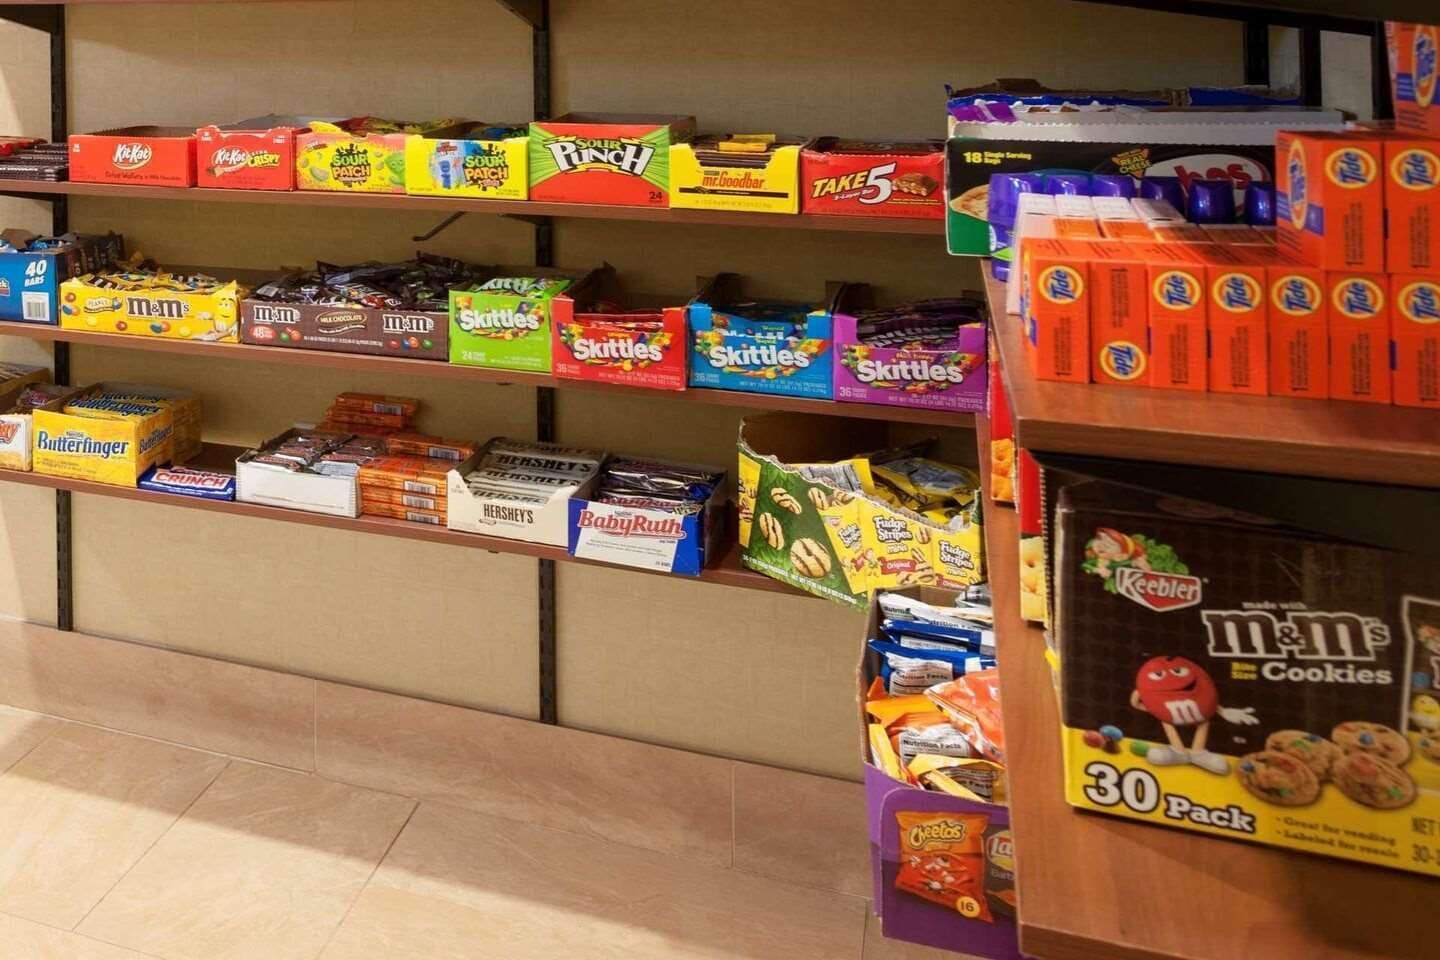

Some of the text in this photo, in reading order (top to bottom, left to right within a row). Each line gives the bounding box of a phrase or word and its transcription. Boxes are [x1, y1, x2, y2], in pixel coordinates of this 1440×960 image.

[576, 139, 621, 150] SOUR
[247, 153, 280, 167] CRISPY
[332, 153, 368, 166] SOUR
[465, 155, 506, 168] SOUR
[547, 140, 655, 177] PUNCH
[963, 151, 982, 164] 18
[1120, 155, 1147, 166] REAL
[1338, 150, 1369, 184] Tide
[332, 165, 372, 178] PATCH
[464, 167, 509, 180] PATCH
[1405, 152, 1436, 186] Tide
[812, 162, 897, 205] TAKE 5
[649, 191, 663, 201] 24
[25, 259, 48, 277] 40
[1050, 269, 1076, 300] Tide
[1165, 274, 1193, 305] Tide
[1225, 276, 1253, 308] Tide
[1284, 278, 1313, 311] Tide
[1344, 281, 1377, 315] Tide
[334, 313, 363, 323] CHOCOLATE
[460, 307, 540, 331] Skittles
[573, 337, 663, 362] Skittles
[709, 343, 810, 369] Skittles
[856, 359, 963, 385] Skittles
[839, 385, 852, 398] 36
[37, 430, 130, 459] Butterfinger
[498, 453, 592, 473] HERSHEY'S
[156, 472, 228, 488] CRUNCH
[482, 503, 534, 524] HERSHEY'S
[874, 515, 907, 531] Fudge
[877, 527, 913, 543] Stripes
[938, 539, 971, 560] Fudge
[886, 560, 912, 570] Original
[939, 553, 974, 571] Stripes
[1119, 569, 1200, 602] Keebler
[1201, 609, 1392, 662] m&m's
[1261, 661, 1394, 686] Cookies
[1083, 761, 1258, 835] 30 Pack
[909, 821, 963, 847] Cheetos
[960, 901, 975, 913] 16
